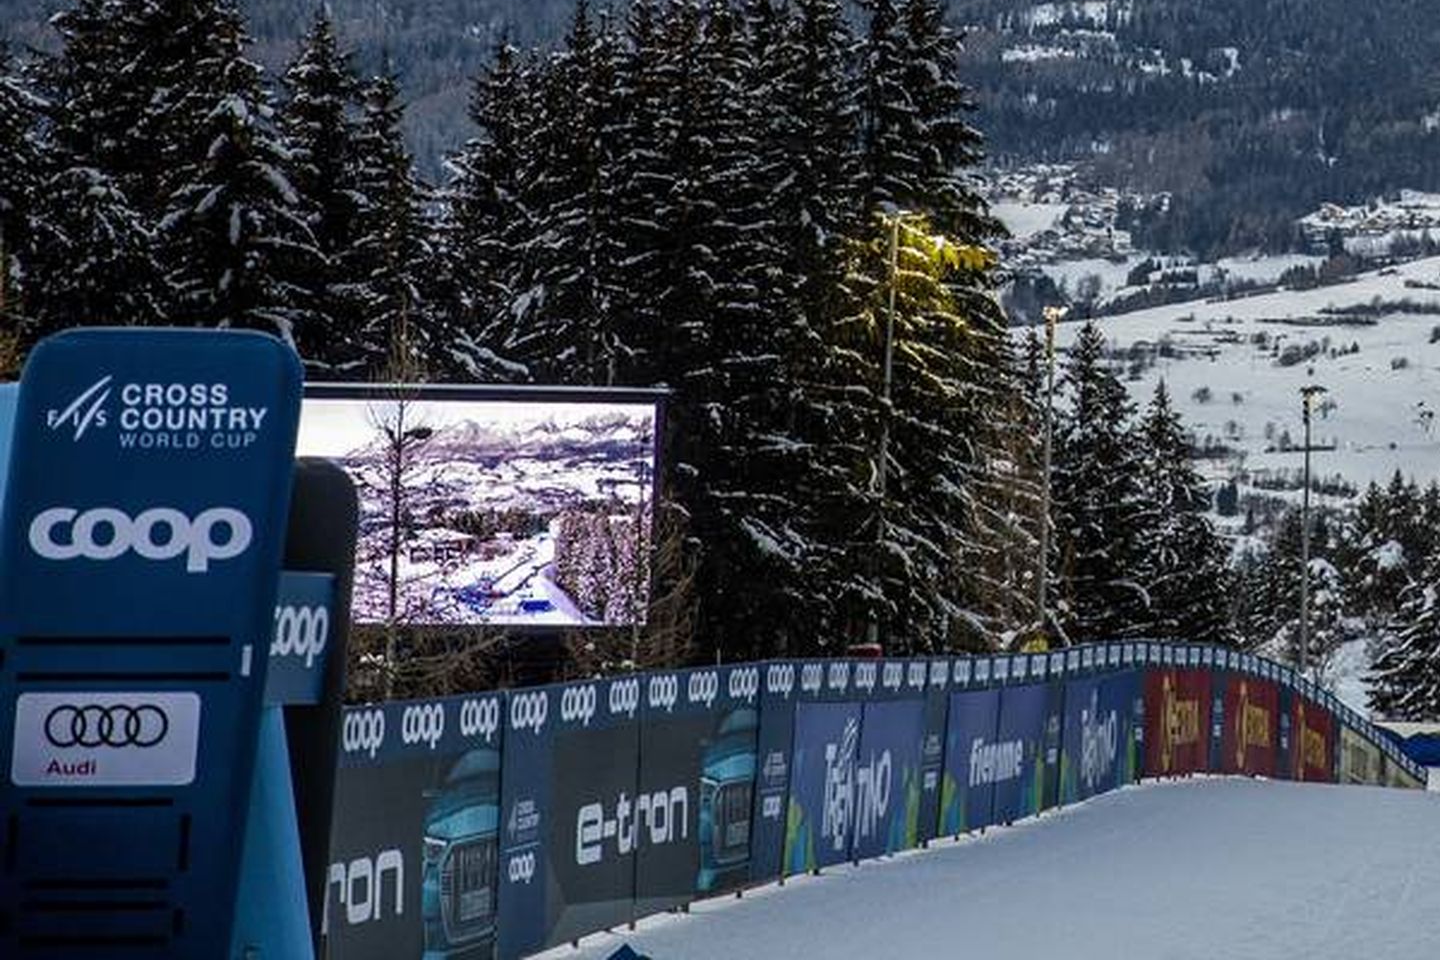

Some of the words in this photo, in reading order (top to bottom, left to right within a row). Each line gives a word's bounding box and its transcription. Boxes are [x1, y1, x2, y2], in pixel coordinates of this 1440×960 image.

[121, 383, 229, 407] CROSS
[119, 432, 200, 449] WORLD
[210, 432, 257, 449] CUP
[120, 407, 268, 431] COUNTRY
[29, 507, 253, 573] coop
[270, 605, 329, 668] oop
[343, 709, 385, 759] coop
[402, 703, 445, 749] coop
[460, 697, 499, 742] coop
[511, 691, 548, 735] coop
[561, 684, 597, 727] coop
[609, 678, 640, 718] coop
[649, 674, 678, 712] coop
[688, 670, 718, 708] coop
[729, 666, 759, 703] coop
[767, 664, 795, 700] coop
[46, 759, 97, 775] Audi
[576, 786, 688, 865] e-tron
